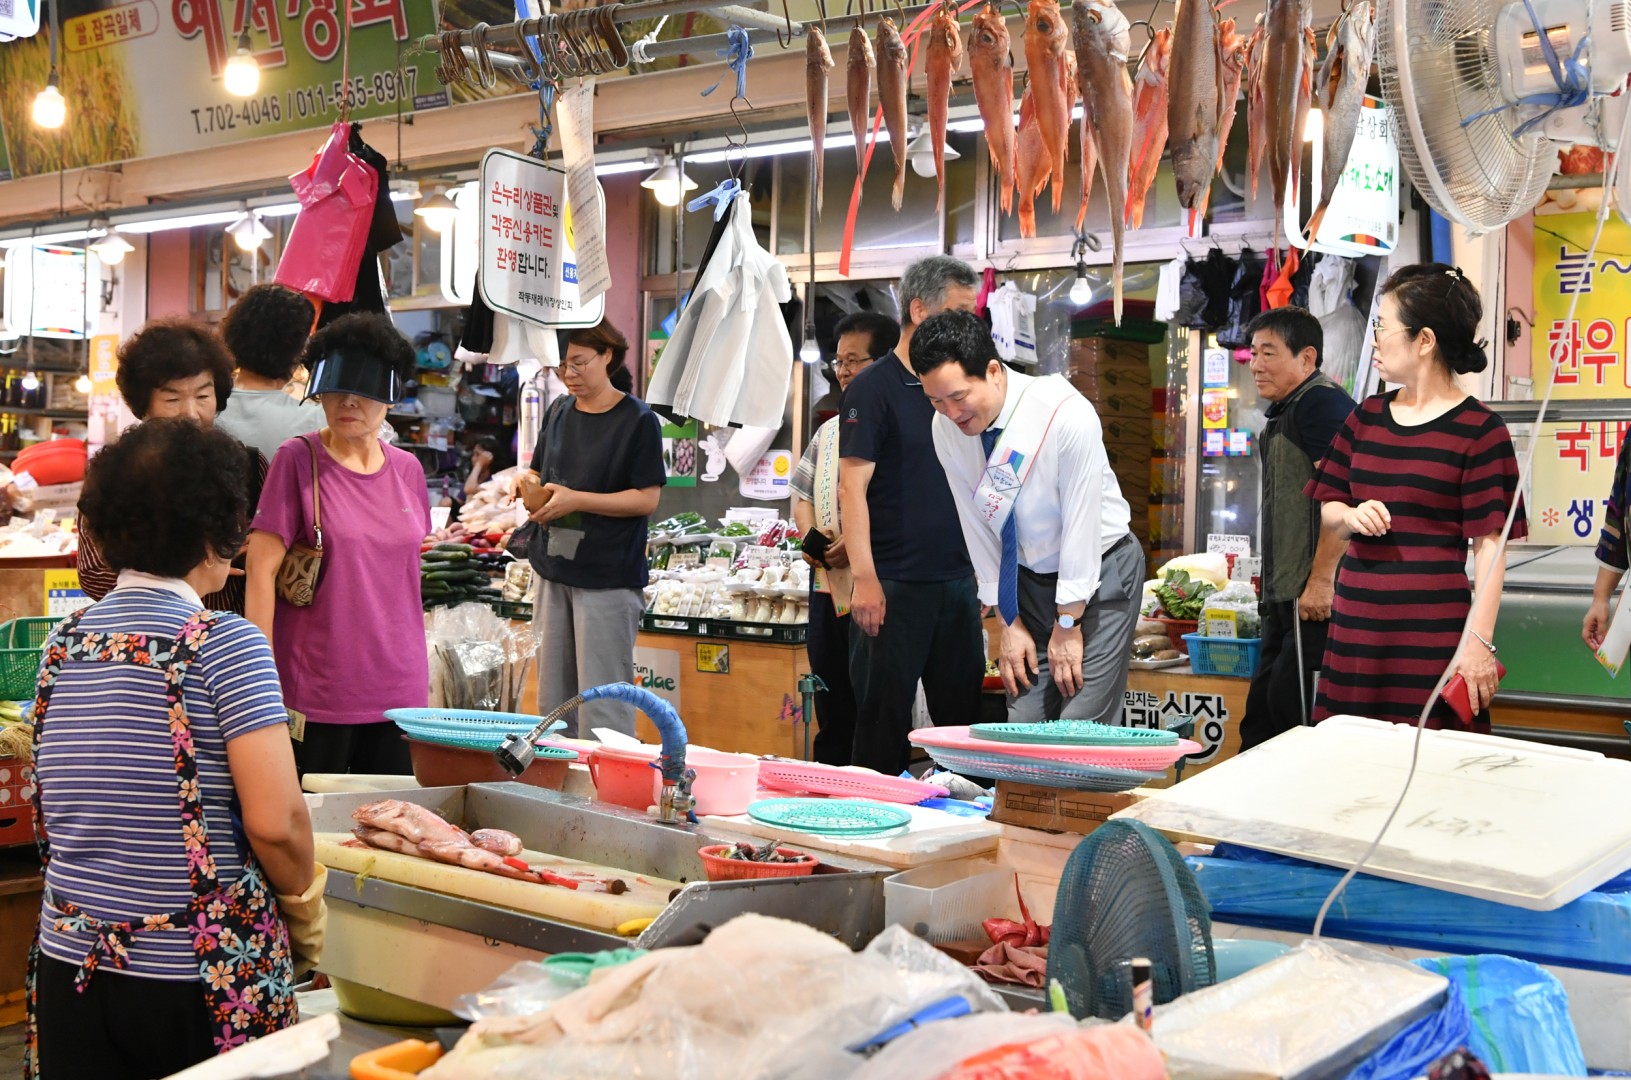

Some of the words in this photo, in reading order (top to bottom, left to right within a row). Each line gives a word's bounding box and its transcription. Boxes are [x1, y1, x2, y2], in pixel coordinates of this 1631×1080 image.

[191, 98, 282, 135] T.702-4046
[491, 181, 523, 210] 온누리
[523, 190, 553, 218] 상품권
[496, 247, 551, 280] 환영합니다.
[1548, 319, 1618, 385] 한우
